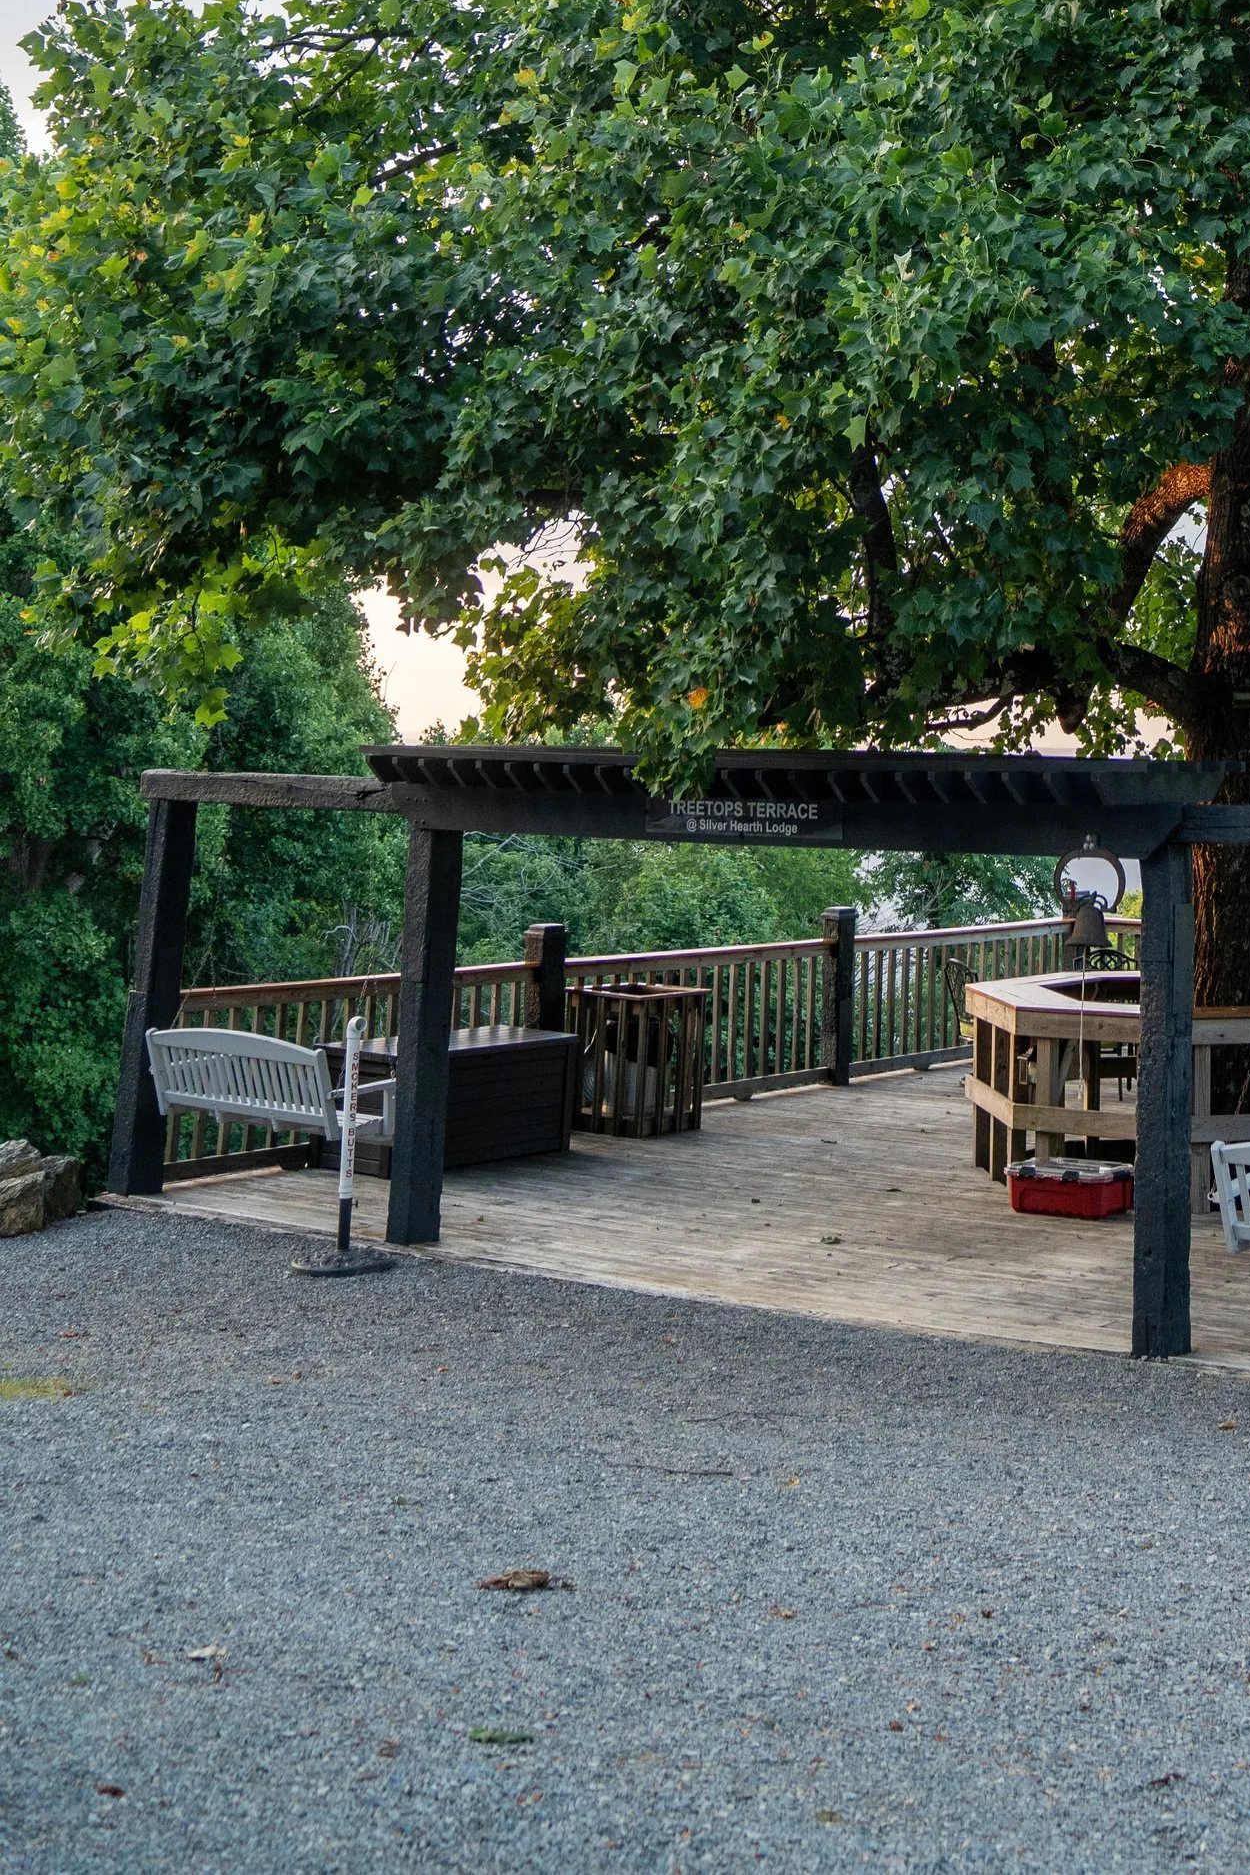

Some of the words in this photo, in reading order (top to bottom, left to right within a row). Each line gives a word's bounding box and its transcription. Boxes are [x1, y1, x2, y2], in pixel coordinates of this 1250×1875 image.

[668, 800, 743, 817] TREETOPS
[747, 802, 818, 820] TERRACE
[686, 818, 697, 832] @
[699, 819, 728, 832] Silver
[730, 820, 763, 833] Hearth
[765, 821, 798, 836] Lodge
[350, 1052, 359, 1122] SMOKERS
[346, 1128, 355, 1178] BUTTS
